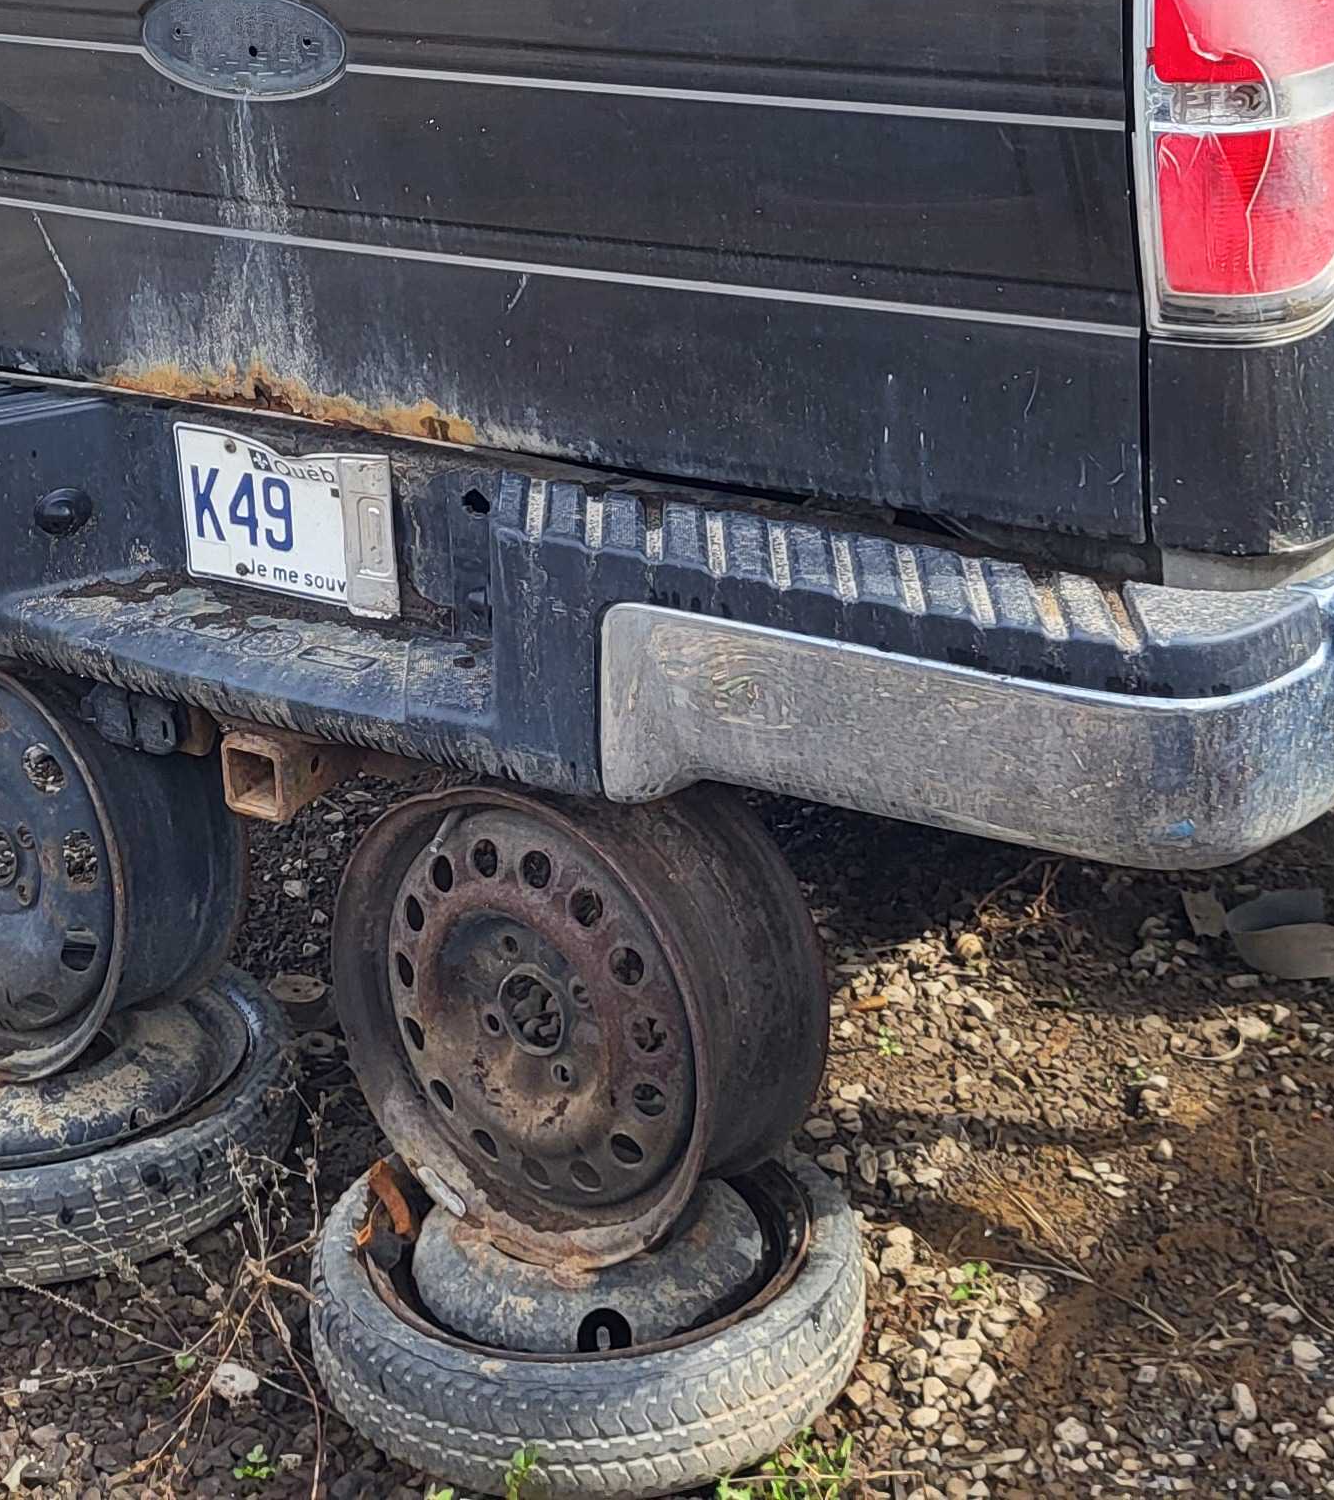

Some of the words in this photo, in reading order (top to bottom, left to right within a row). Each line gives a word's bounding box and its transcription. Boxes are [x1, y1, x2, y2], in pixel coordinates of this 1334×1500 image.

[190, 464, 295, 553] K49
[248, 558, 268, 577] Je
[272, 566, 299, 584] me
